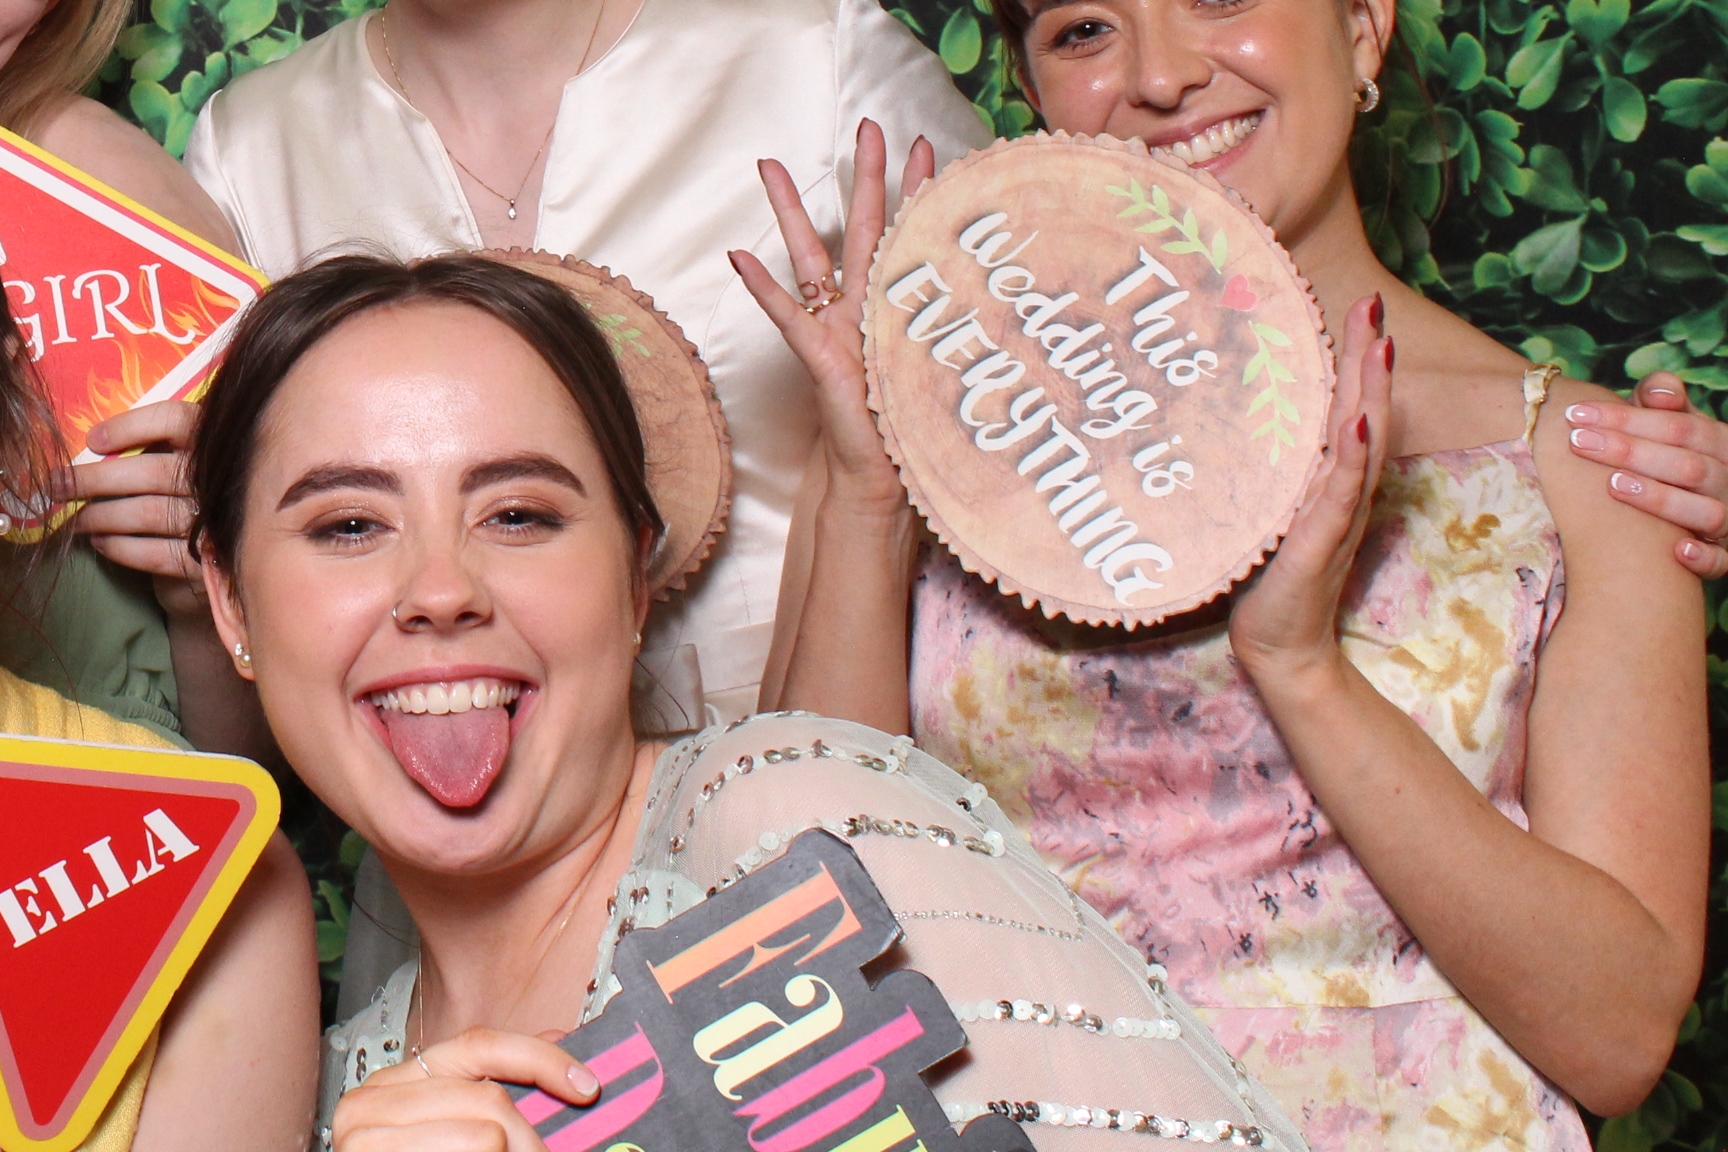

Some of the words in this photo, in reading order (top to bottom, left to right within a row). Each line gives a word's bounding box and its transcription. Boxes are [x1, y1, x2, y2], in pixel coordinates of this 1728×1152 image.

[2, 262, 196, 363] GIRL
[958, 211, 1158, 439] Wedding
[1132, 434, 1195, 498] is
[1105, 245, 1219, 387] This
[885, 261, 1173, 607] EVERYTHING
